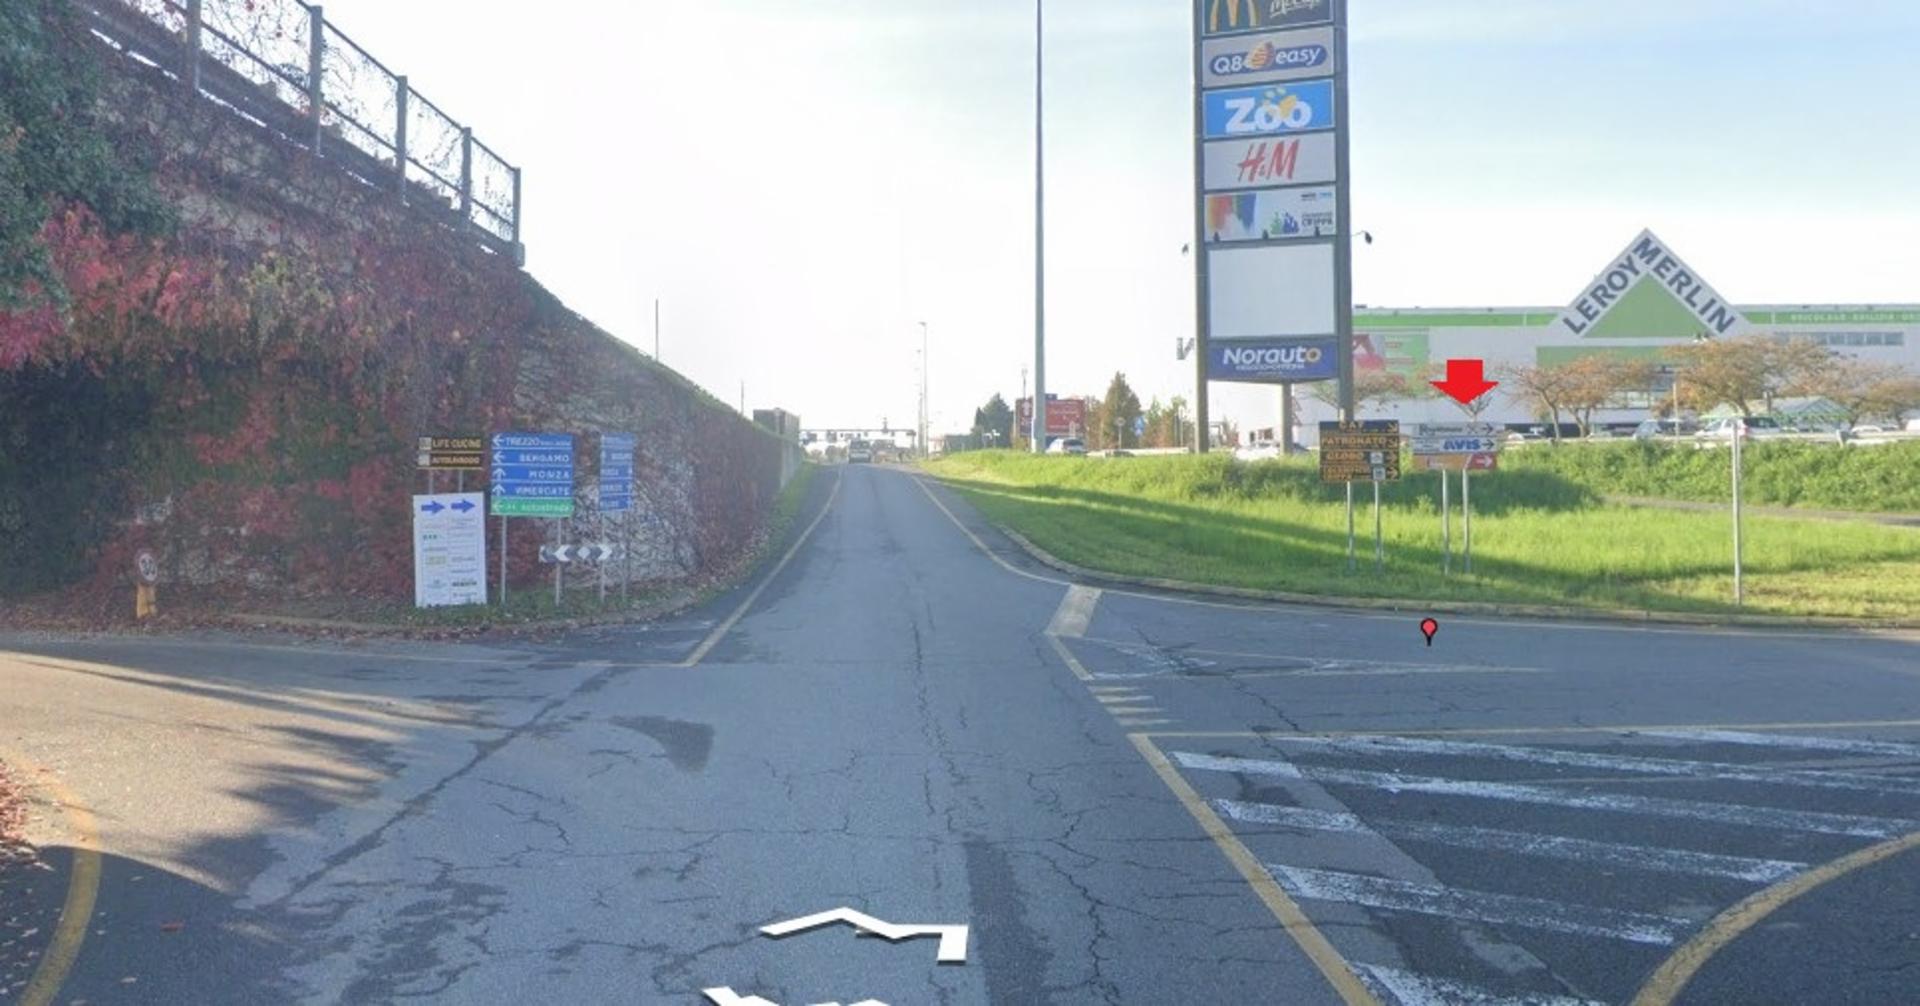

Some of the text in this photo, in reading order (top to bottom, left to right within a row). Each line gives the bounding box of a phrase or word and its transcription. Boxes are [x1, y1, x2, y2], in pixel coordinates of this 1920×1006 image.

[1213, 46, 1321, 74] Q8 easy
[1237, 139, 1300, 182] H&M
[1562, 237, 1736, 335] LEROY MERLIN
[1223, 346, 1322, 365] Norauto
[505, 437, 540, 446] TREZZO
[1443, 439, 1481, 450] AVIS
[519, 453, 570, 463] BERGAMO
[528, 470, 570, 479] MONZA
[514, 486, 570, 496] VIMERCATE
